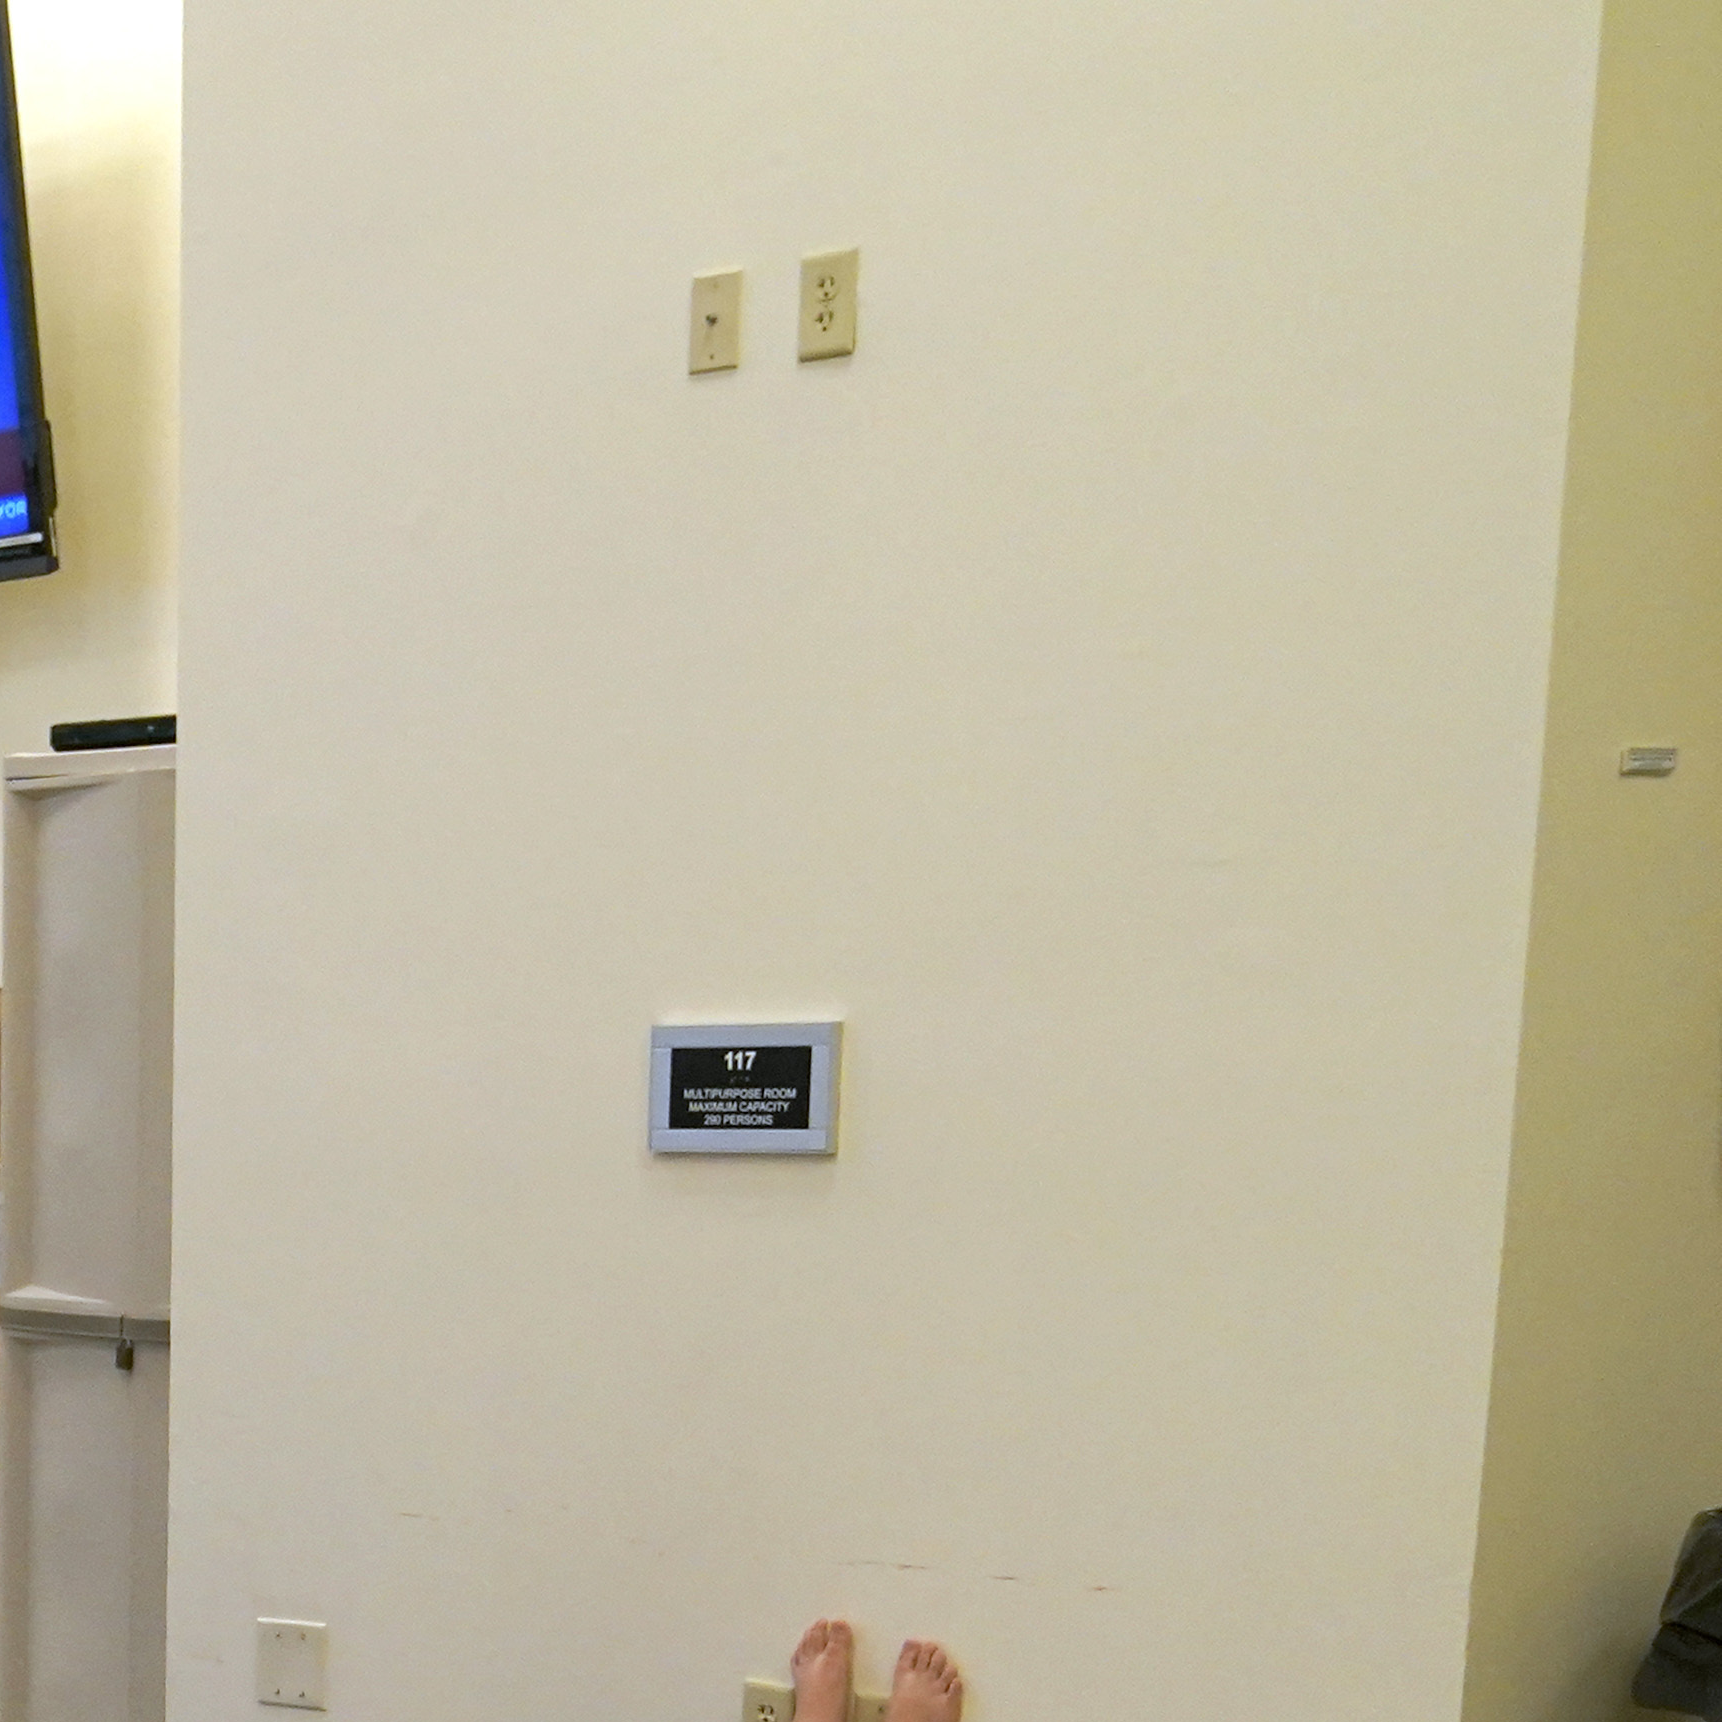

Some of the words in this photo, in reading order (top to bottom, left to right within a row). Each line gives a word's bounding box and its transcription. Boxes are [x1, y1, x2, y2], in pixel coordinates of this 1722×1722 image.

[723, 1050, 757, 1071] 117
[683, 1087, 762, 1100] MULTIPURPOSE
[763, 1087, 797, 1099] ROOM
[688, 1101, 737, 1112] MAXIMUM
[738, 1100, 790, 1112] CAPACITY
[722, 1113, 774, 1126] PERSONS
